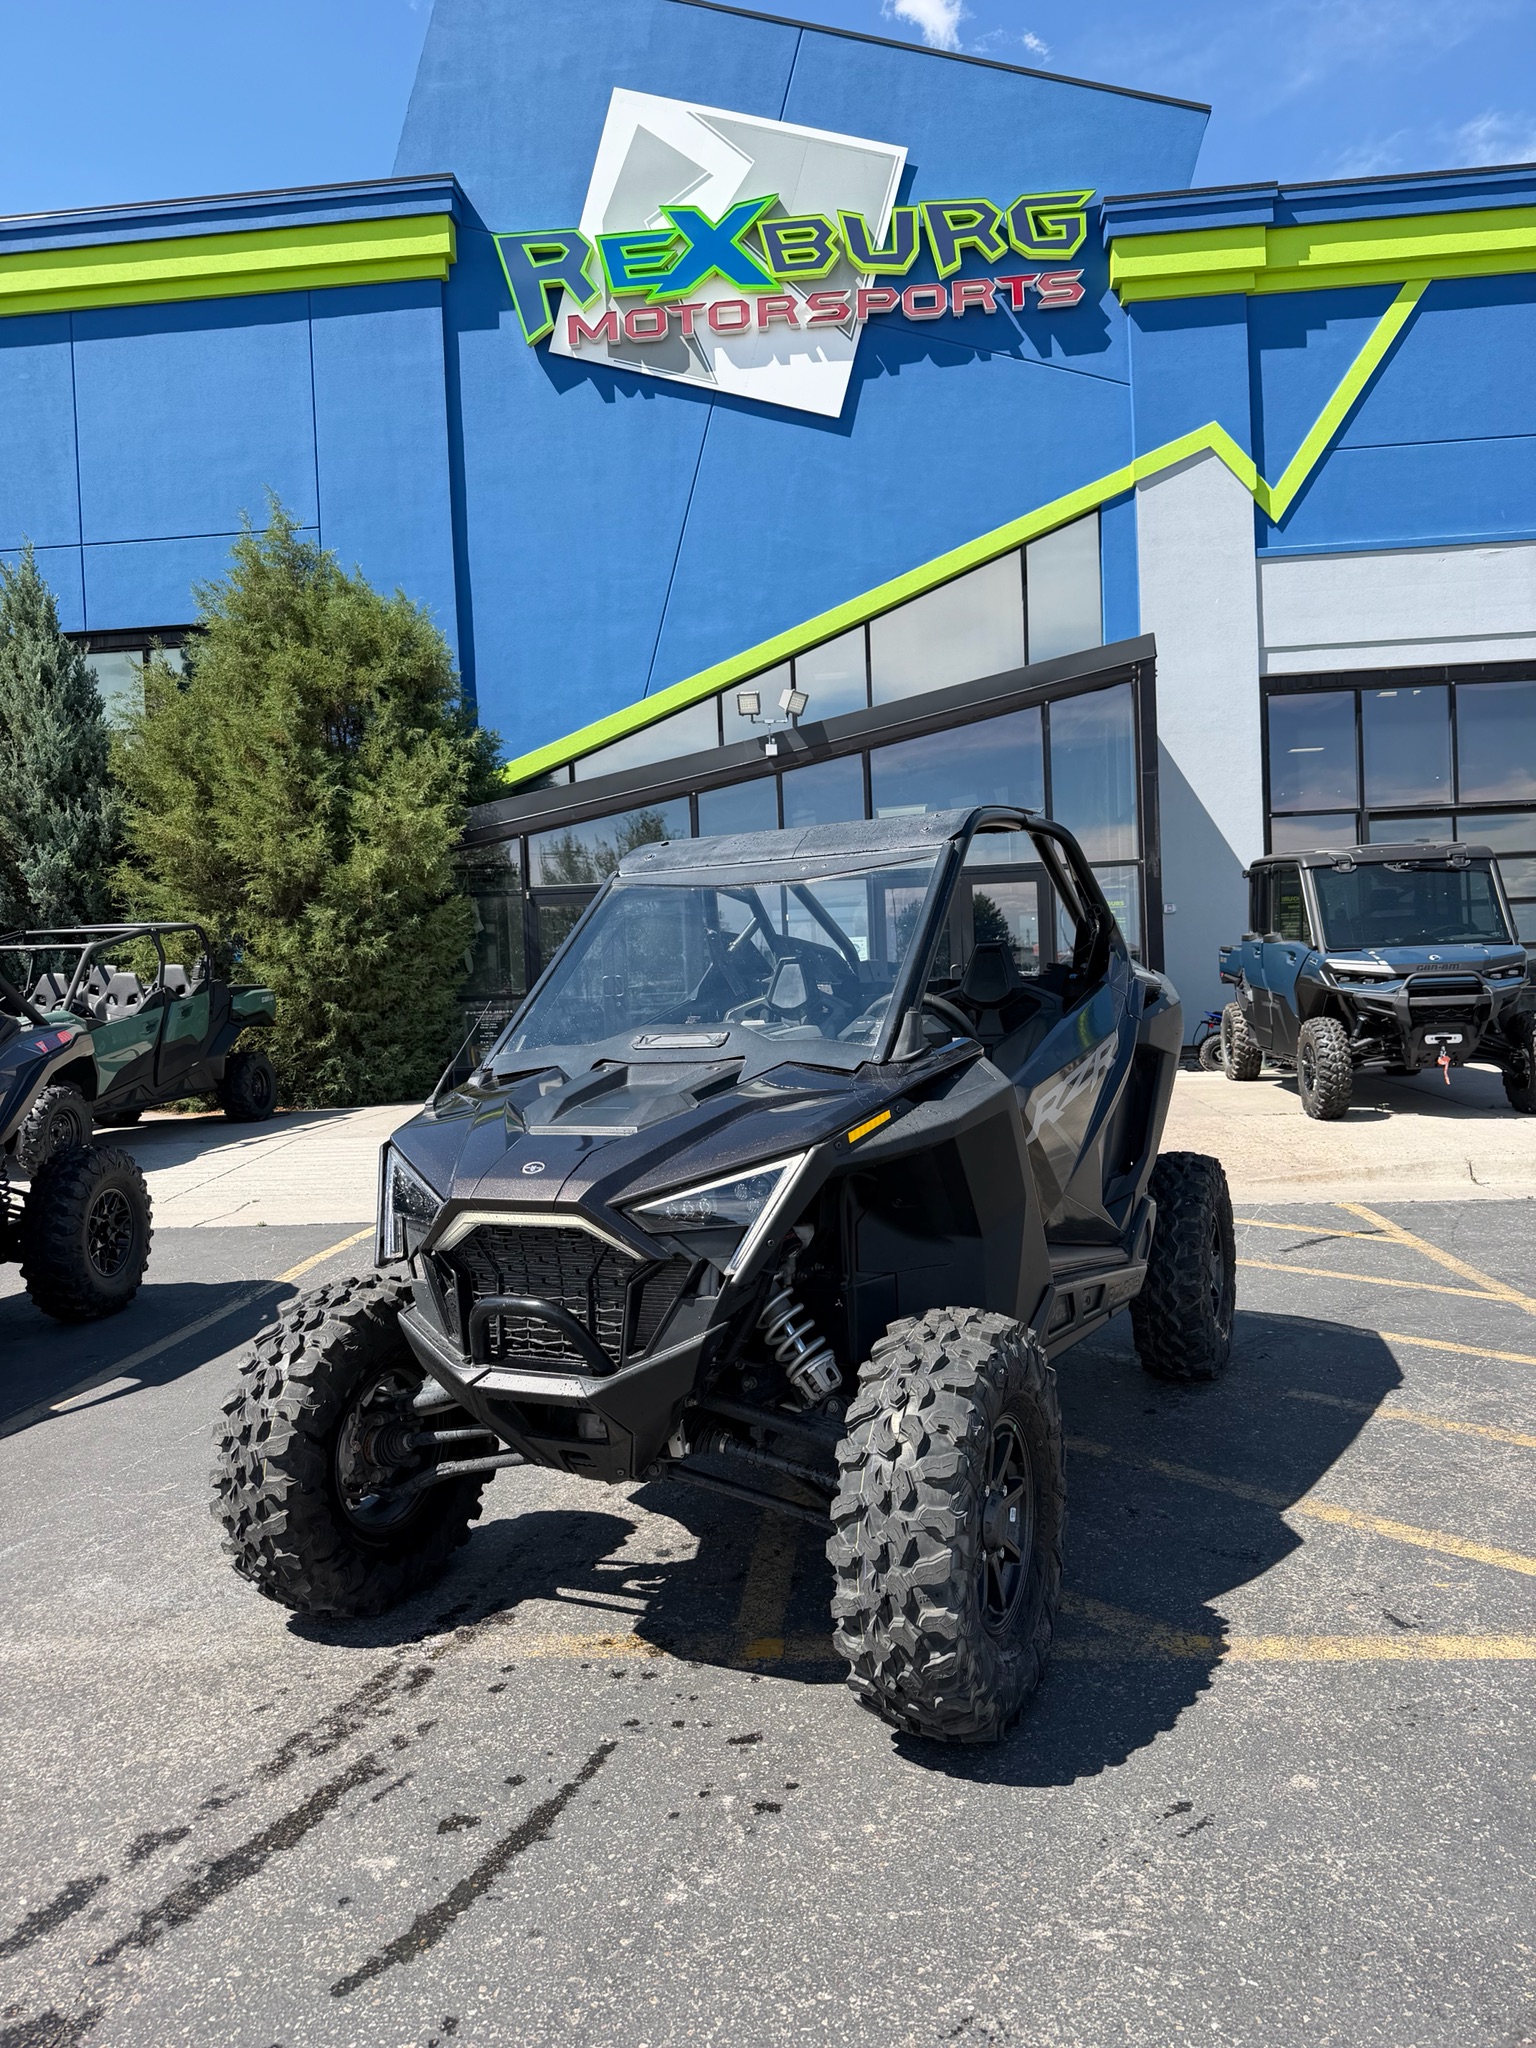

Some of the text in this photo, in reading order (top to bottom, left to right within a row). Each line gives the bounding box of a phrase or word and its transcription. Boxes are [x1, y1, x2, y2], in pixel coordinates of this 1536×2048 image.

[494, 189, 1097, 347] REXBURG
[567, 269, 1087, 349] MOTORSPORTS
[1026, 1031, 1118, 1145] RZR
